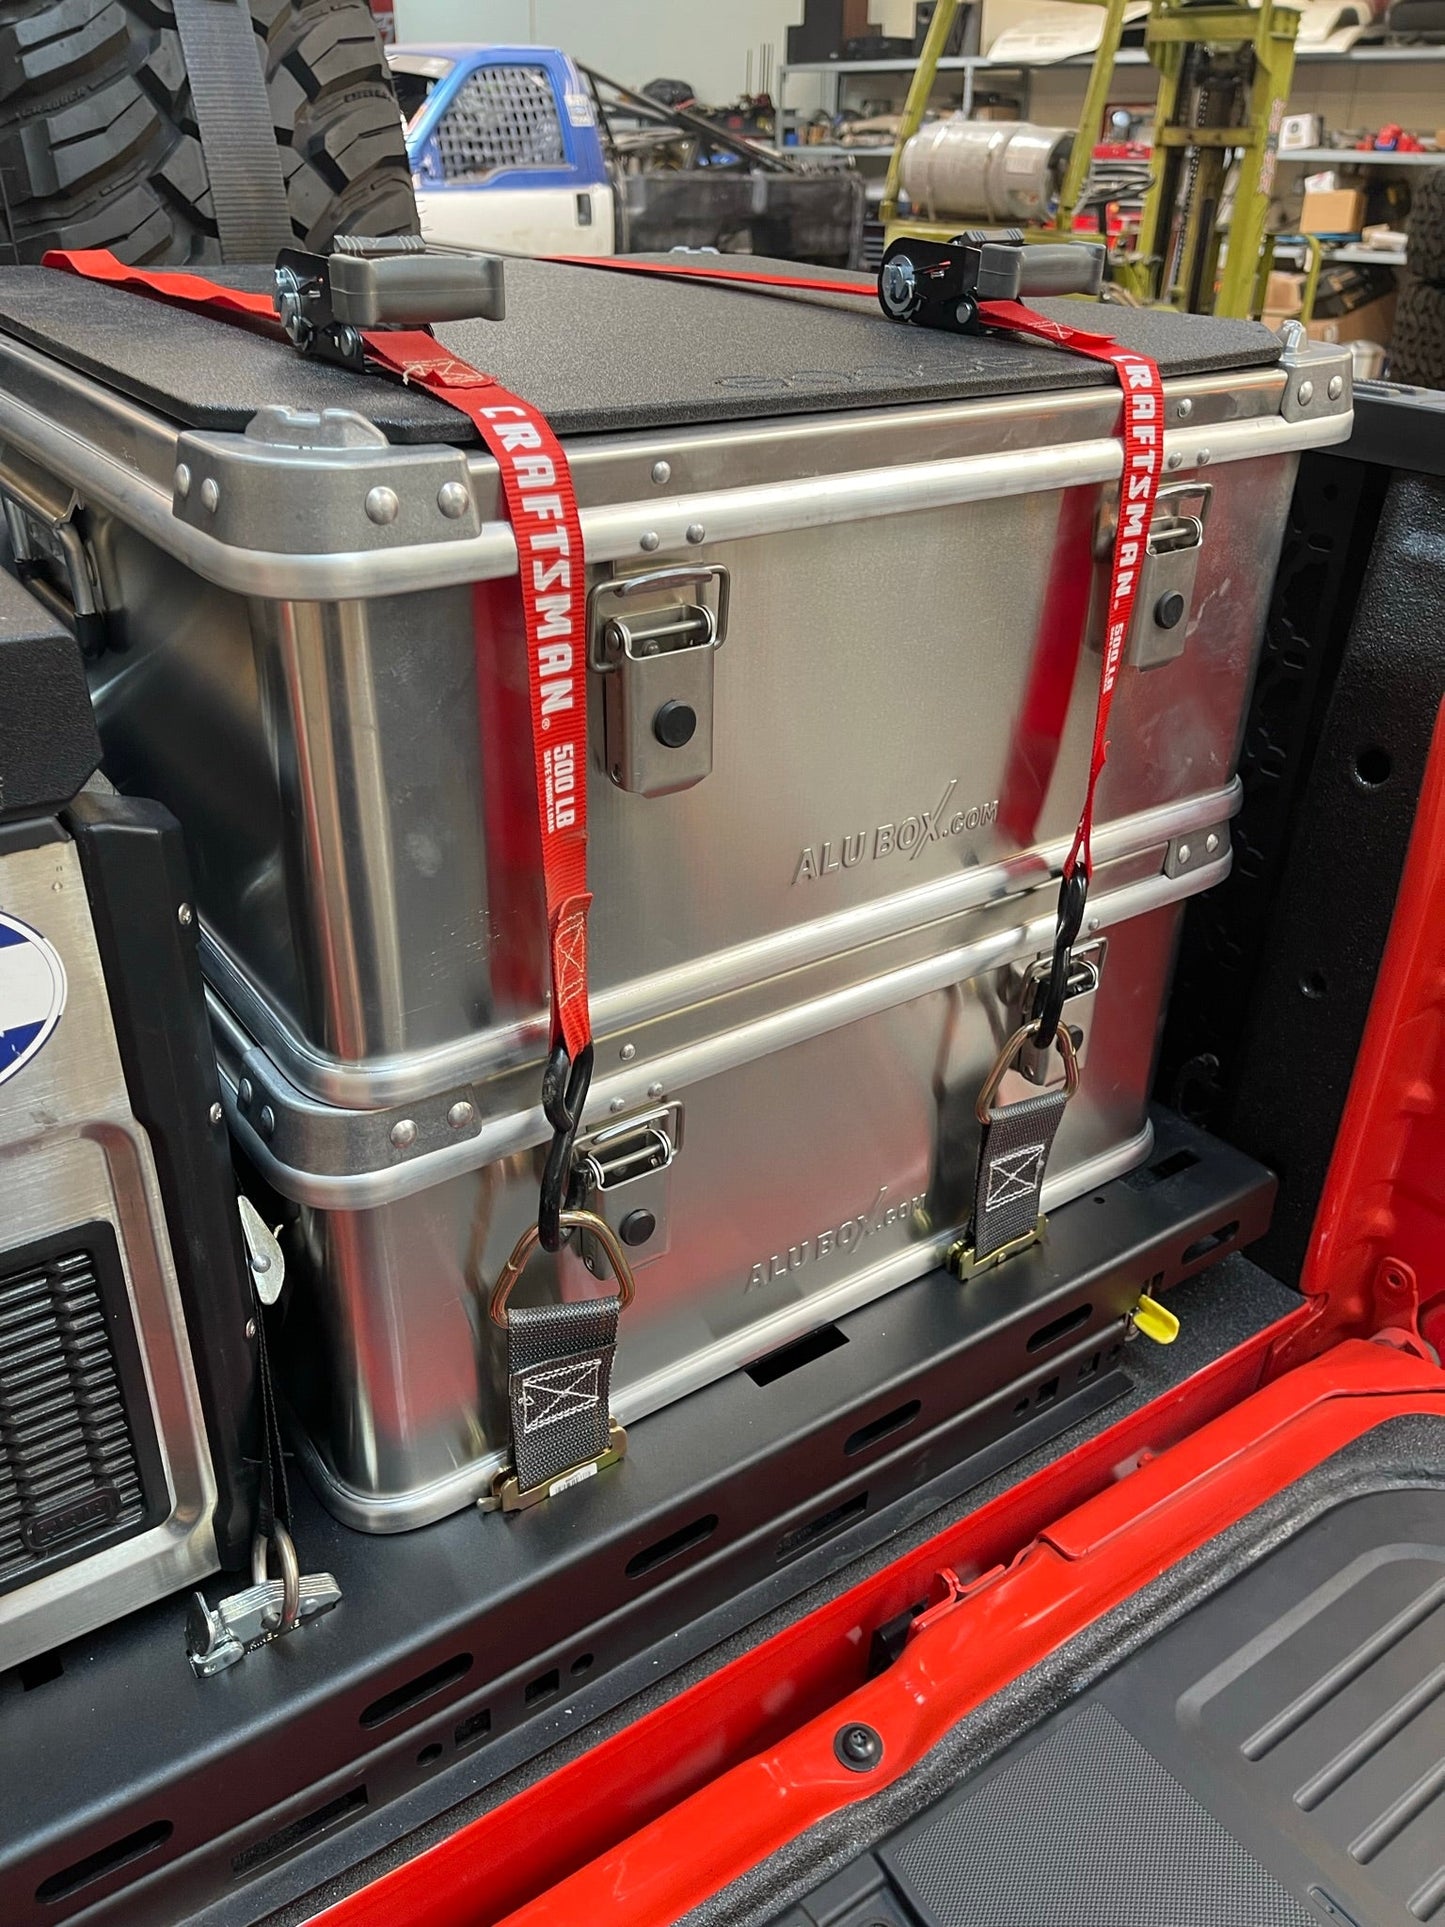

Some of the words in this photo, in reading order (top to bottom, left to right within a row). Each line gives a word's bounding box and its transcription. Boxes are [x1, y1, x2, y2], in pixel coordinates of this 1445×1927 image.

[543, 750, 552, 776] SAFE
[554, 744, 574, 793] 500
[546, 776, 554, 807] WORK
[556, 797, 575, 828] LB
